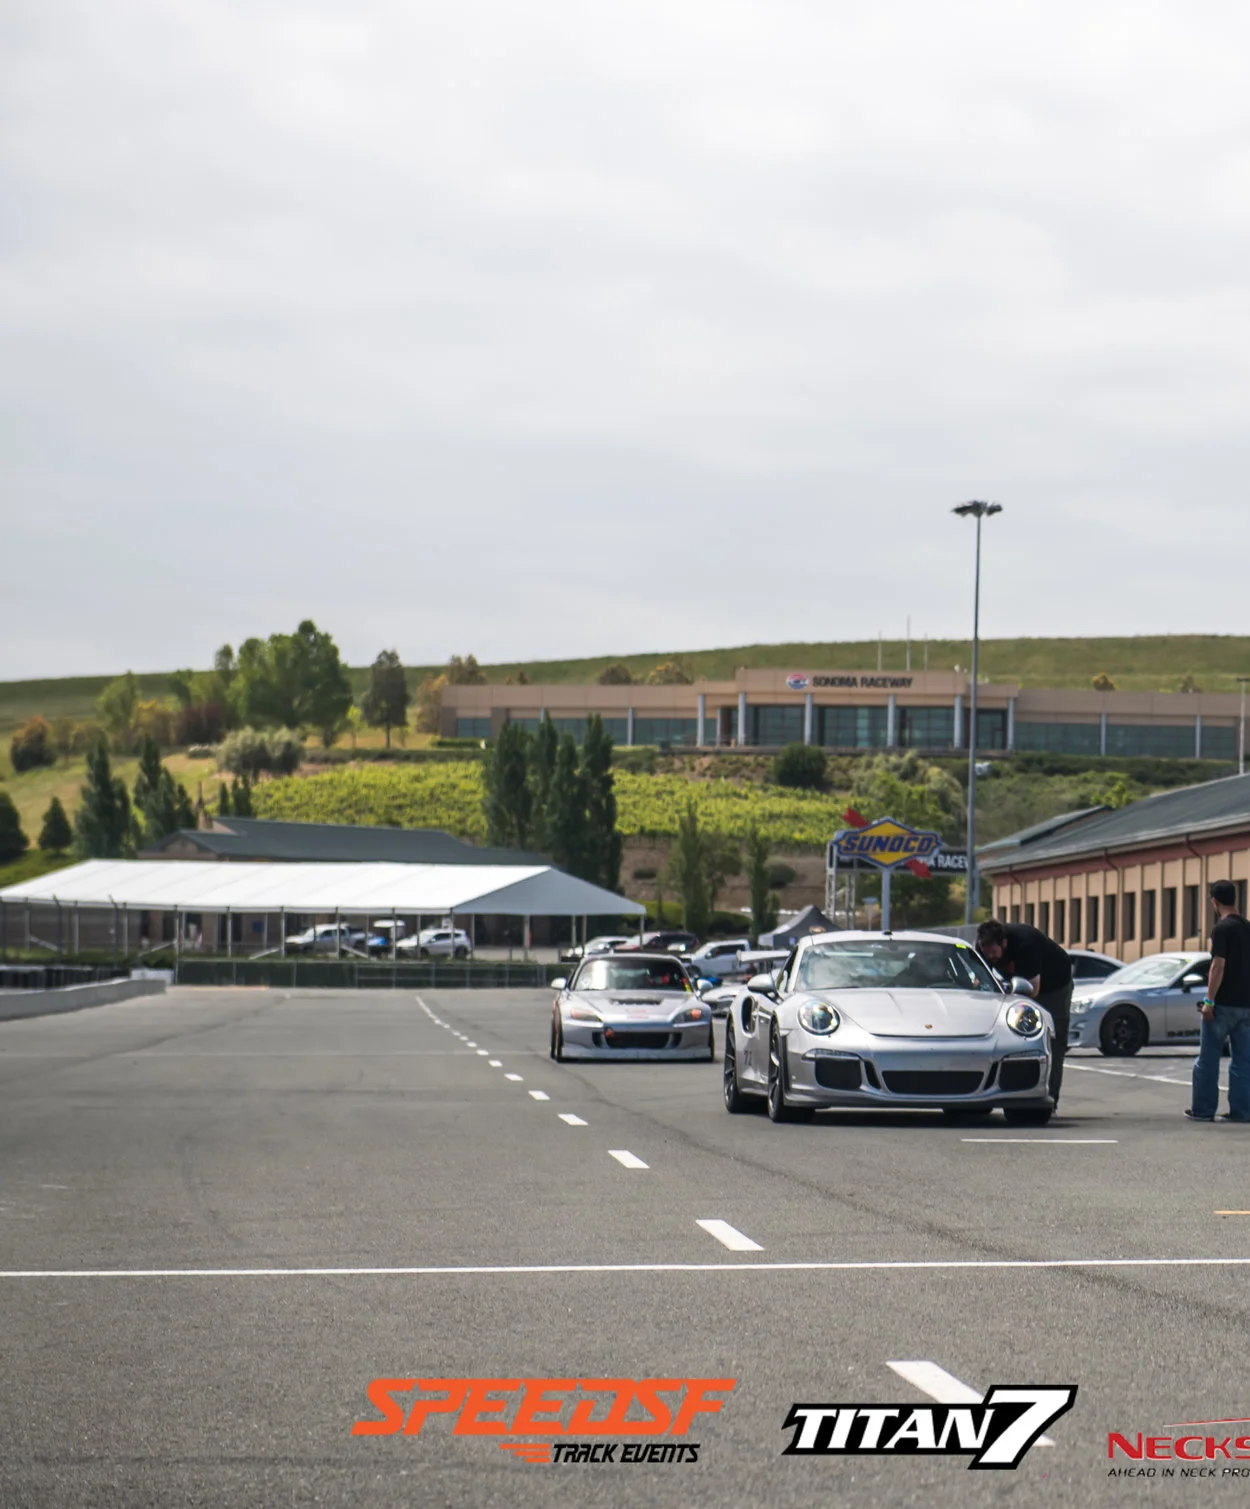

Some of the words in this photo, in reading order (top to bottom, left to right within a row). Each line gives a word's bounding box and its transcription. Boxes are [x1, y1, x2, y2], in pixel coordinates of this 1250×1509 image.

[812, 676, 857, 688] SONOMA
[860, 676, 913, 688] RACEWAY
[843, 835, 934, 853] SUNOCO
